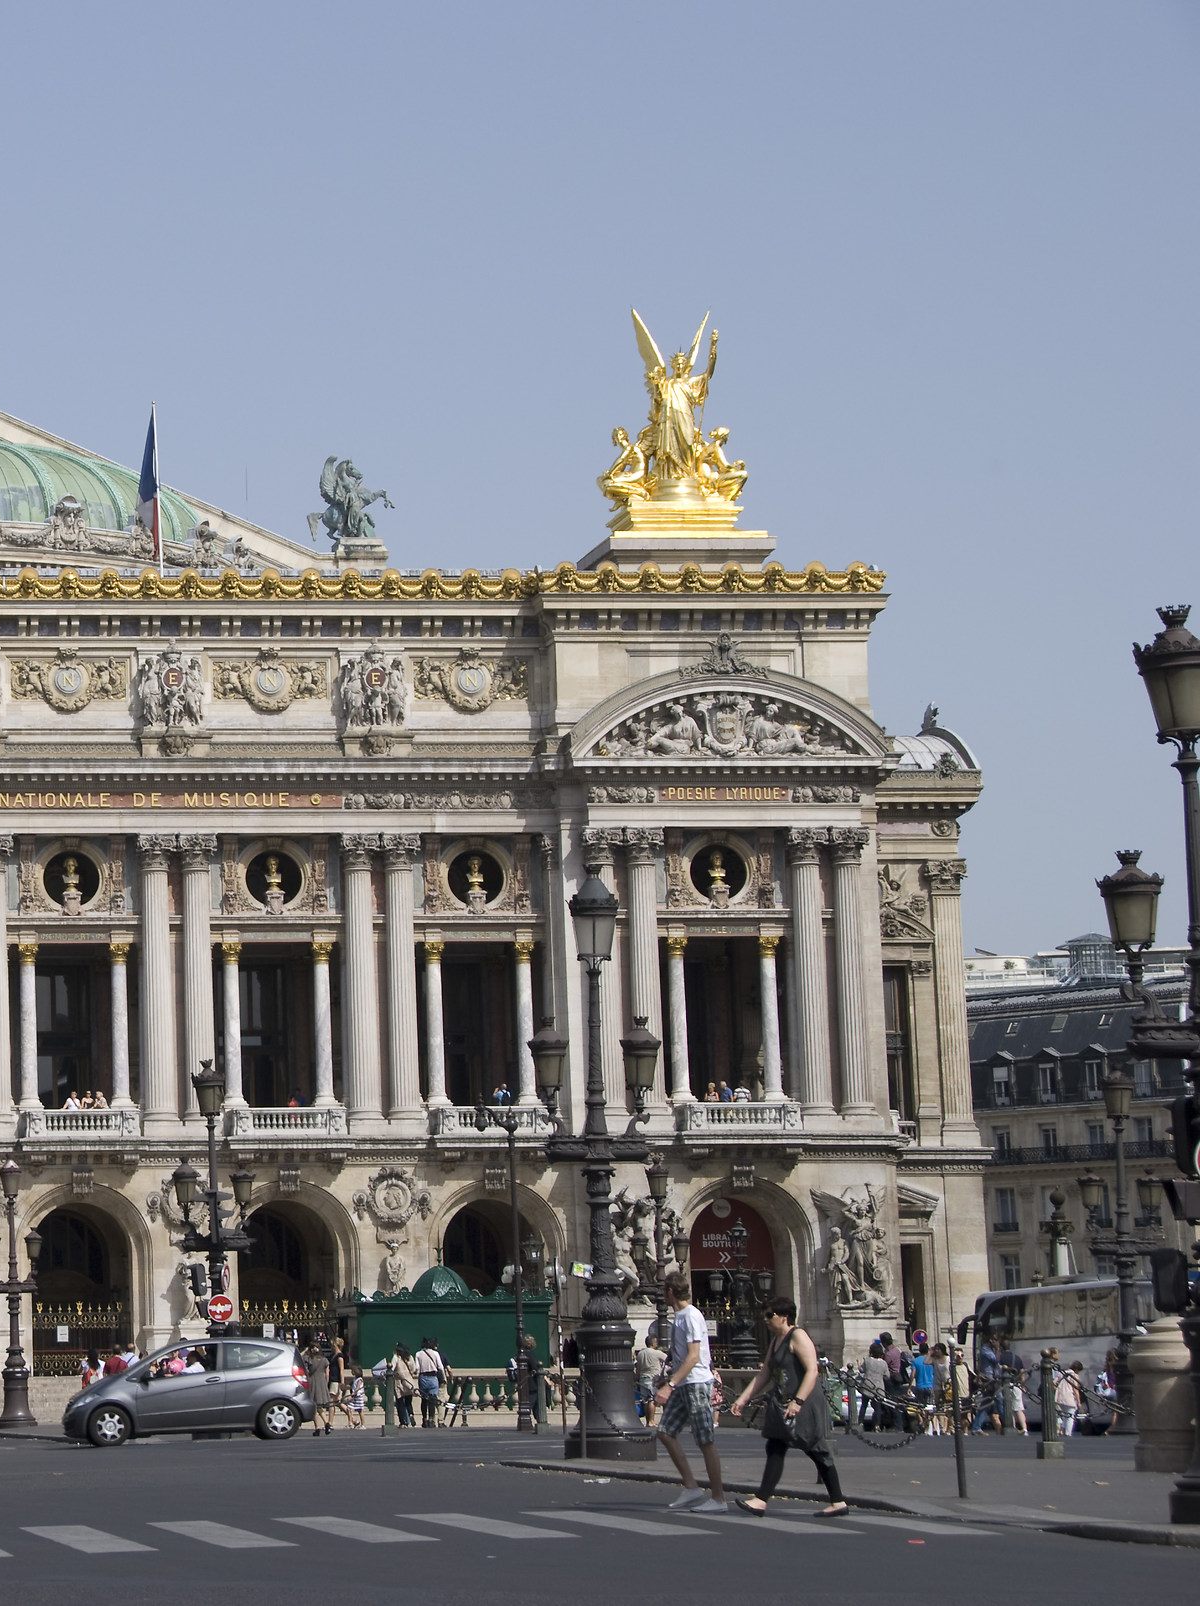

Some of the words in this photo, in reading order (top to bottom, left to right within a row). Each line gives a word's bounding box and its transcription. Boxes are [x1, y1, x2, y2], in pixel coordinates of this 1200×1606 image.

[63, 673, 74, 687] N
[169, 673, 178, 684] E
[264, 673, 276, 687] N
[371, 673, 380, 684] E
[466, 673, 477, 687] N
[133, 792, 162, 807] DE
[184, 792, 289, 807] MUSIQUE
[668, 787, 717, 800] POESIE
[726, 787, 780, 800] LYRIQUE
